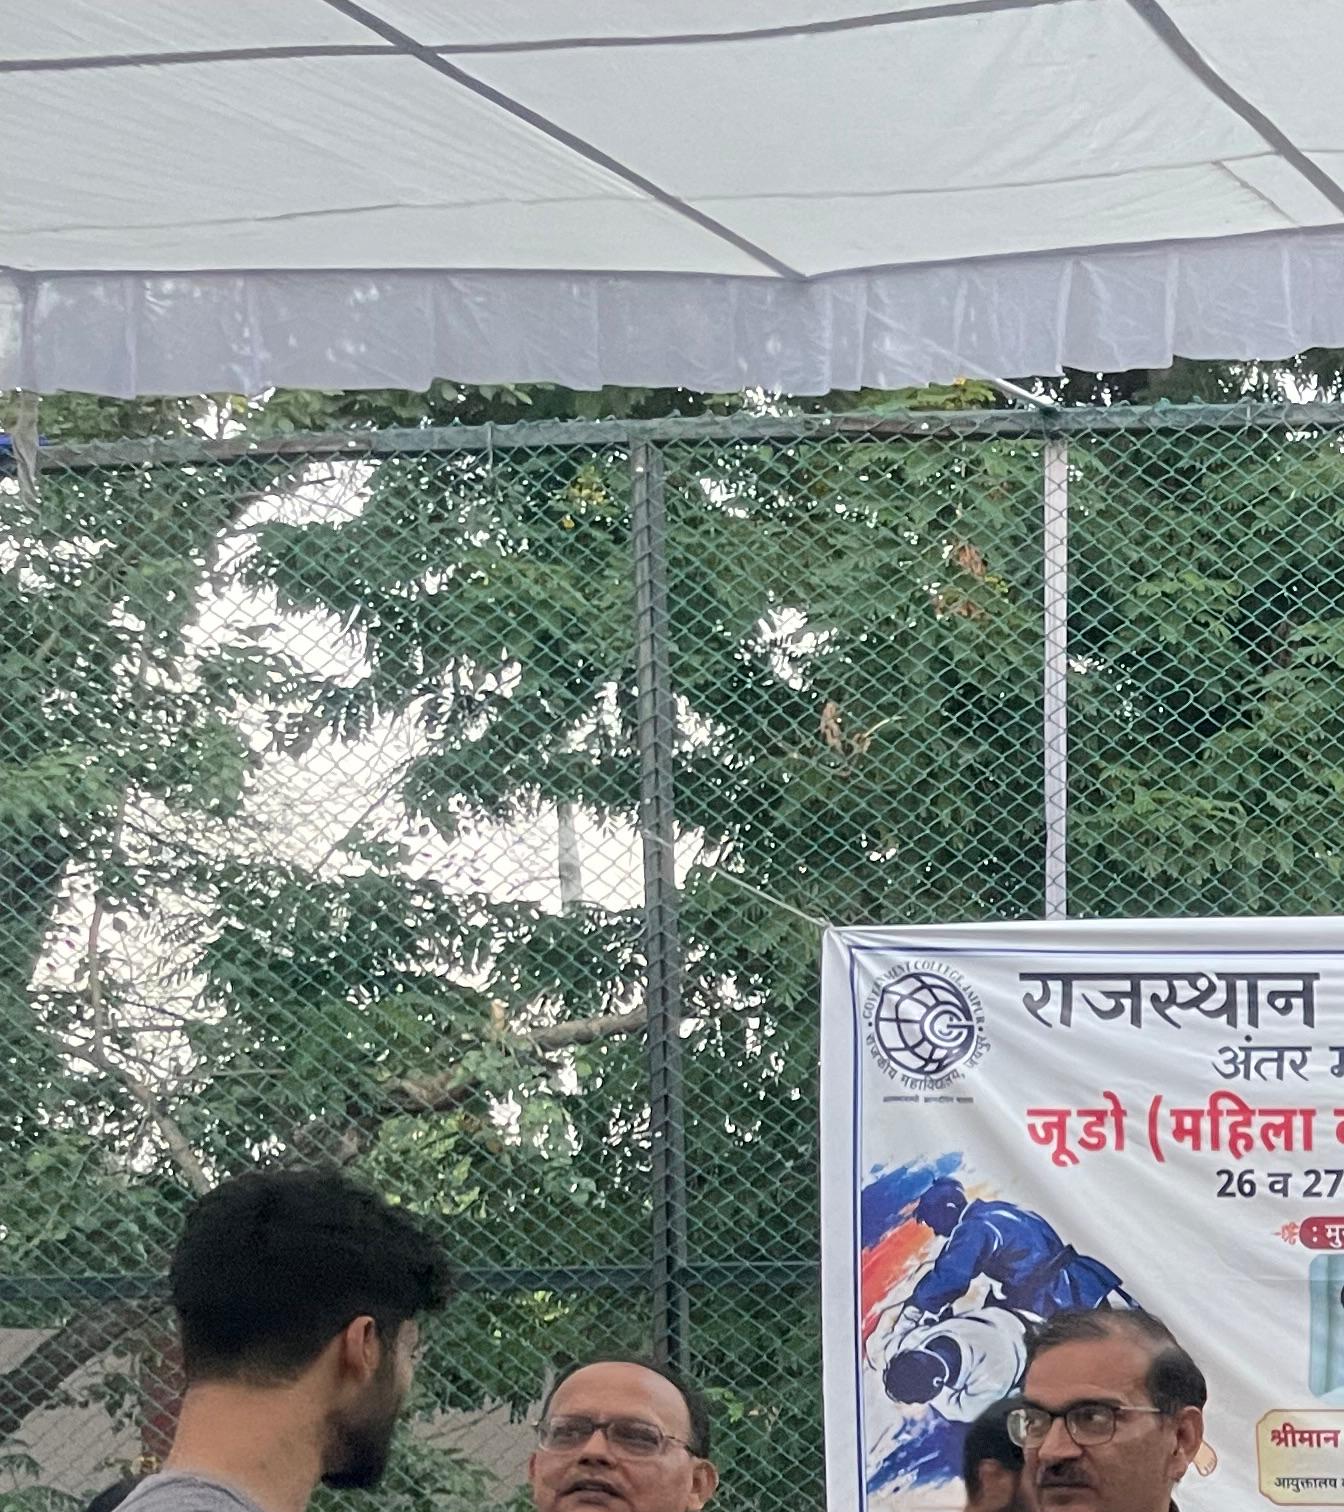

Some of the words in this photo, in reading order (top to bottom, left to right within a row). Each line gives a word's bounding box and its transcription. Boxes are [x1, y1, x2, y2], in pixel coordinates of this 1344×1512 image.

[1019, 970, 1321, 1030] राजस्थान
[1211, 1034, 1313, 1082] अंतर
[1026, 1090, 1128, 1168] जूडो
[1215, 1168, 1258, 1199] 26
[1267, 1172, 1293, 1198] व
[1302, 1168, 1344, 1199] 27
[1270, 1421, 1341, 1449] श्रीमान
